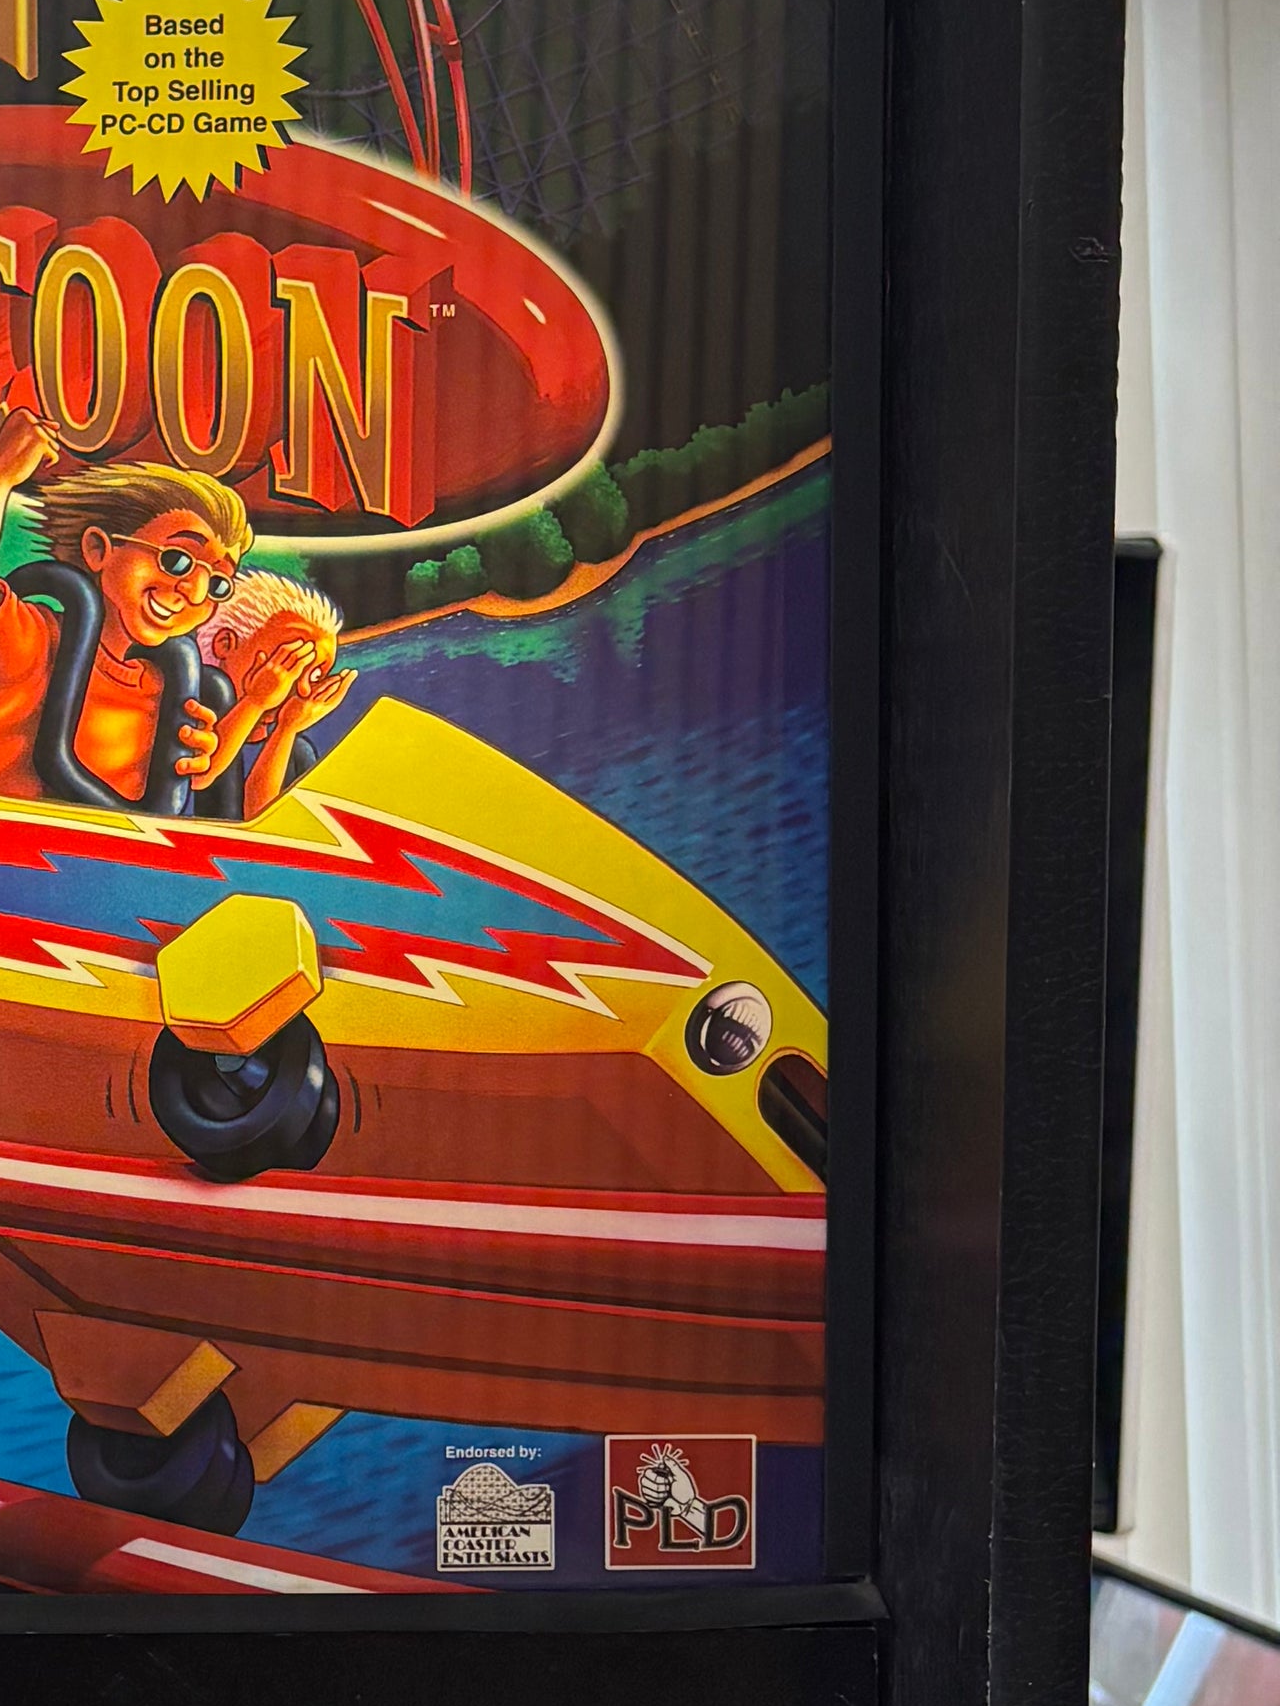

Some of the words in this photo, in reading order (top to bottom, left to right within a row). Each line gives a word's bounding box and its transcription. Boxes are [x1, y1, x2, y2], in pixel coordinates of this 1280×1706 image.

[144, 14, 225, 36] Based
[144, 51, 176, 69] on
[183, 48, 225, 69] the
[112, 81, 160, 107] Top
[168, 79, 256, 105] Selling
[101, 114, 186, 136] PC-CD
[194, 112, 268, 134] Game
[444, 1445, 516, 1460] Endorsed
[519, 1444, 543, 1461] by:
[612, 1486, 750, 1553] PLD
[443, 1524, 532, 1538] AMERICAN
[443, 1539, 517, 1551] COASTER
[442, 1551, 551, 1564] ENTHUSIASTS
